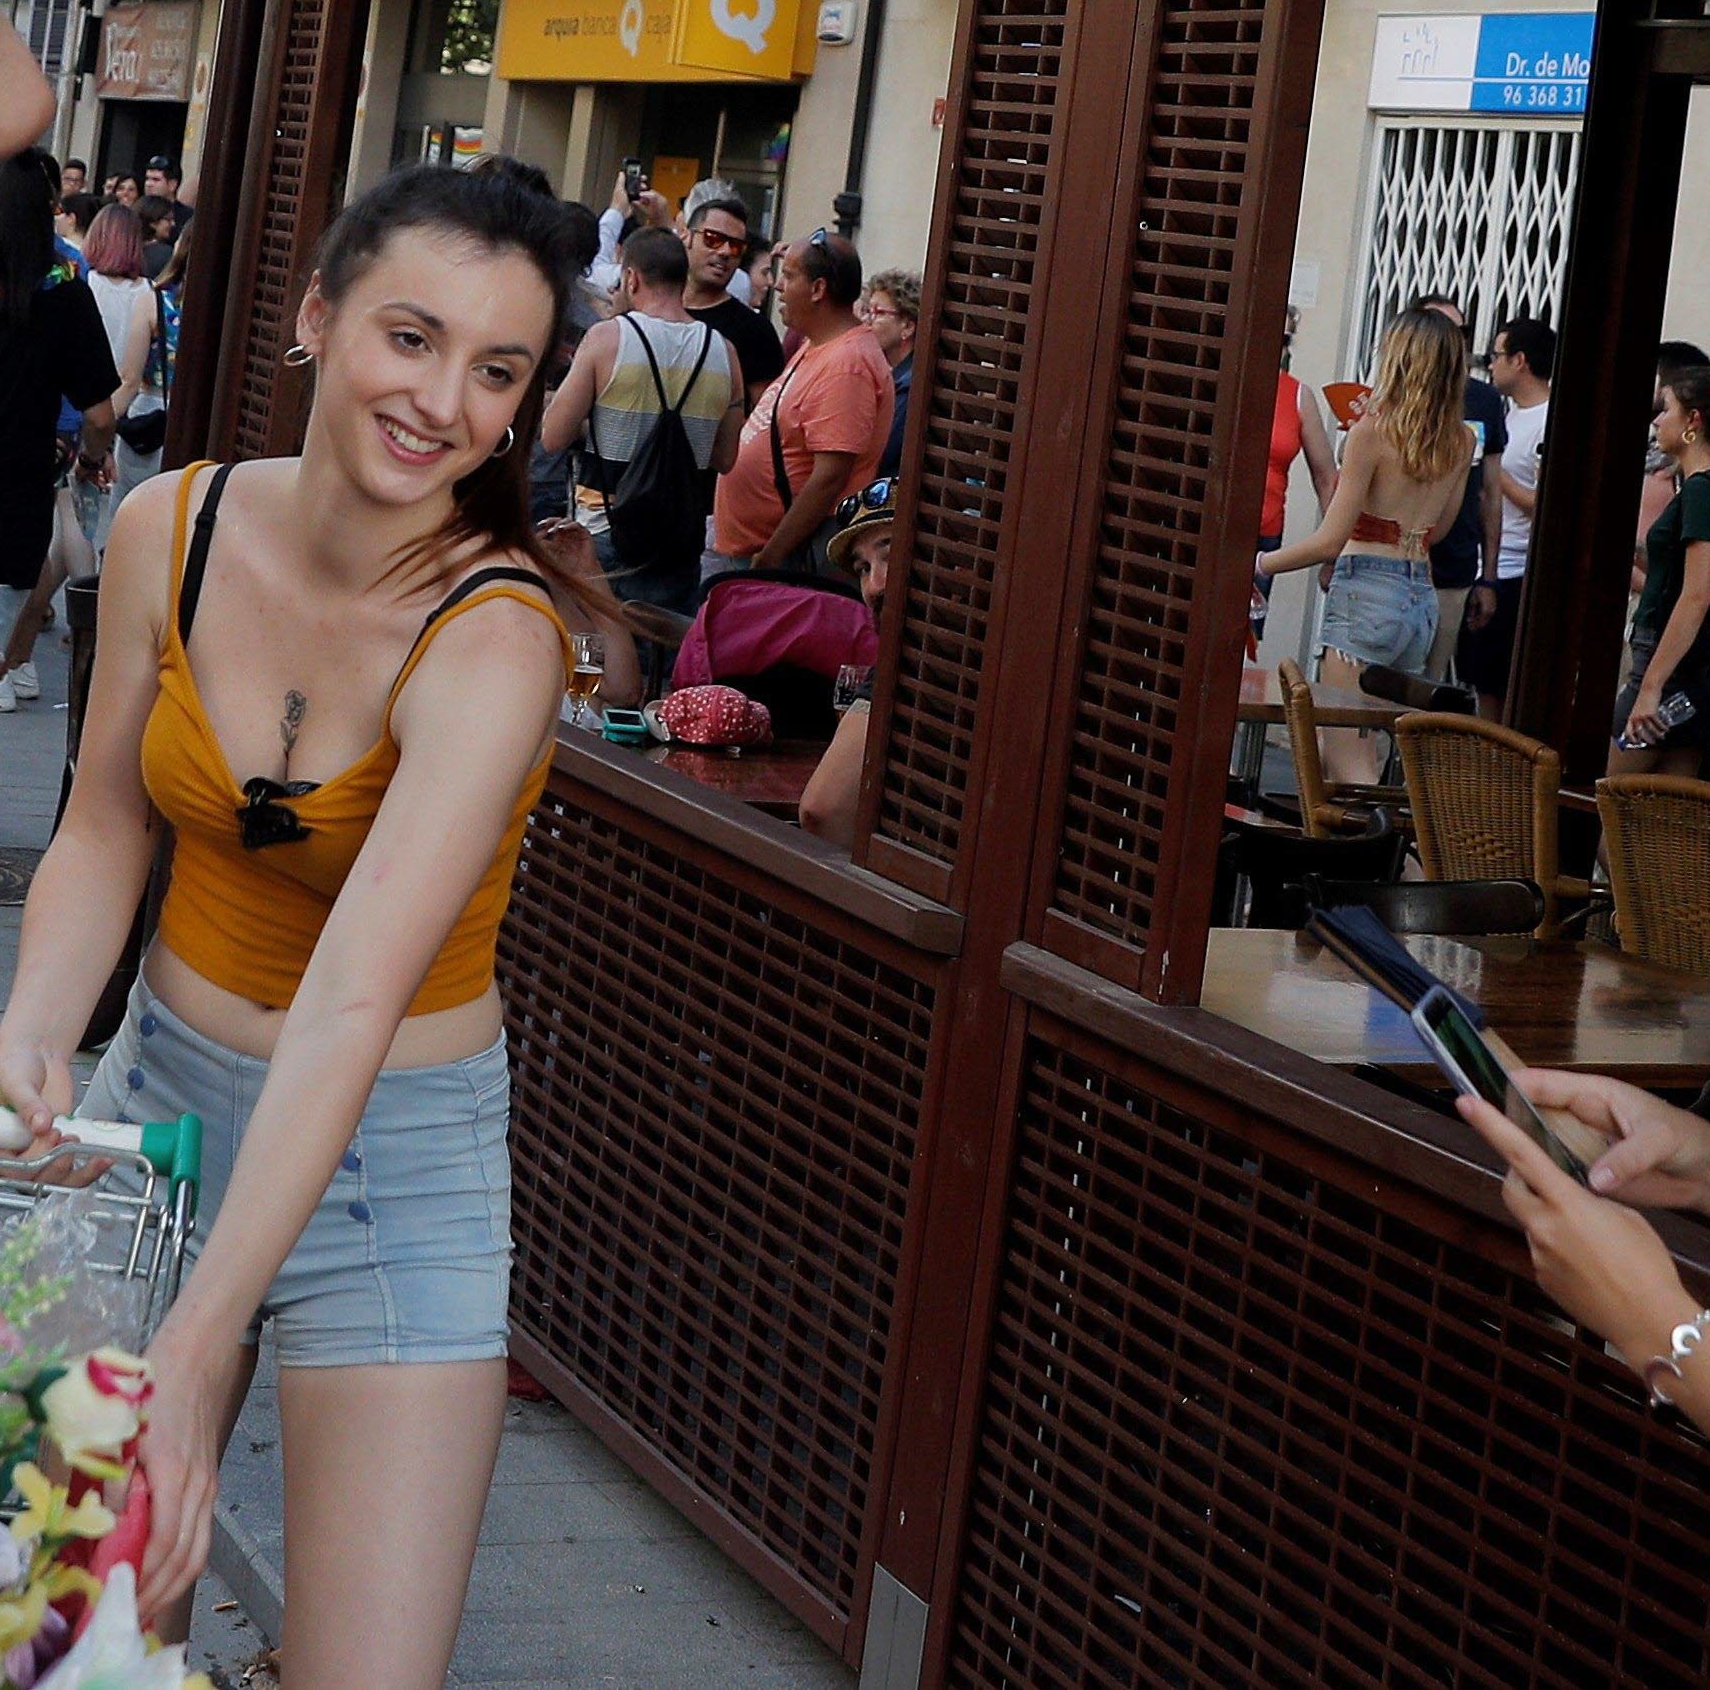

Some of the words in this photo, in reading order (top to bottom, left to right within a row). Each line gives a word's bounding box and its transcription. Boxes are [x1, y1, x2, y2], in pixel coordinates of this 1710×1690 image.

[1505, 52, 1530, 77] Dr.
[1535, 51, 1559, 77] de
[1503, 85, 1522, 106] 96
[1527, 85, 1558, 107] 368
